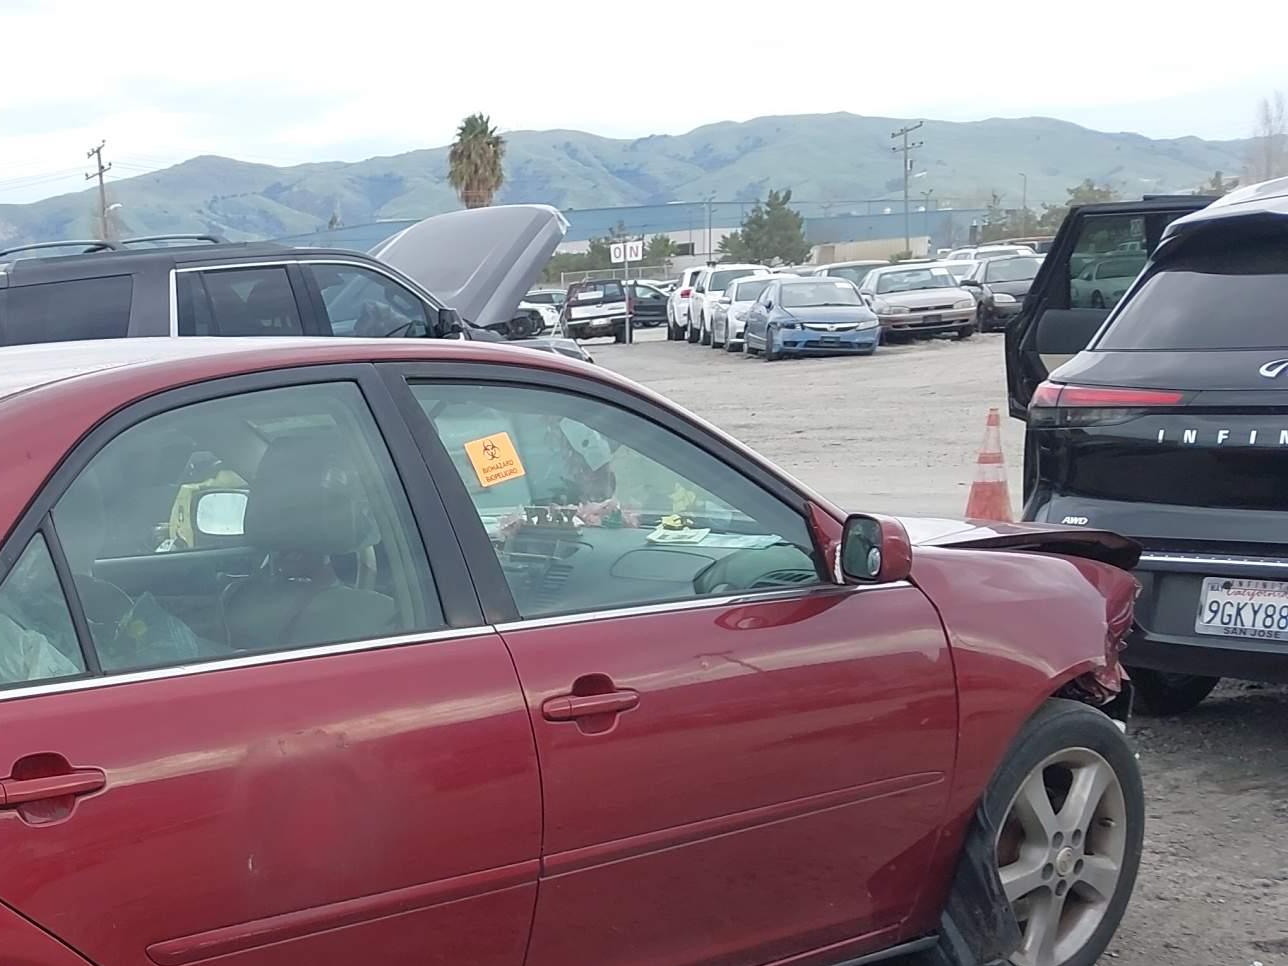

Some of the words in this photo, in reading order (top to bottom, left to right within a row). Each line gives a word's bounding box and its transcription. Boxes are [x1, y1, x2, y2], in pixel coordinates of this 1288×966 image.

[1061, 516, 1088, 525] AWD
[1206, 600, 1288, 629] 9GKY88
[1223, 627, 1247, 636] SAN
[1250, 629, 1281, 639] JOSE
